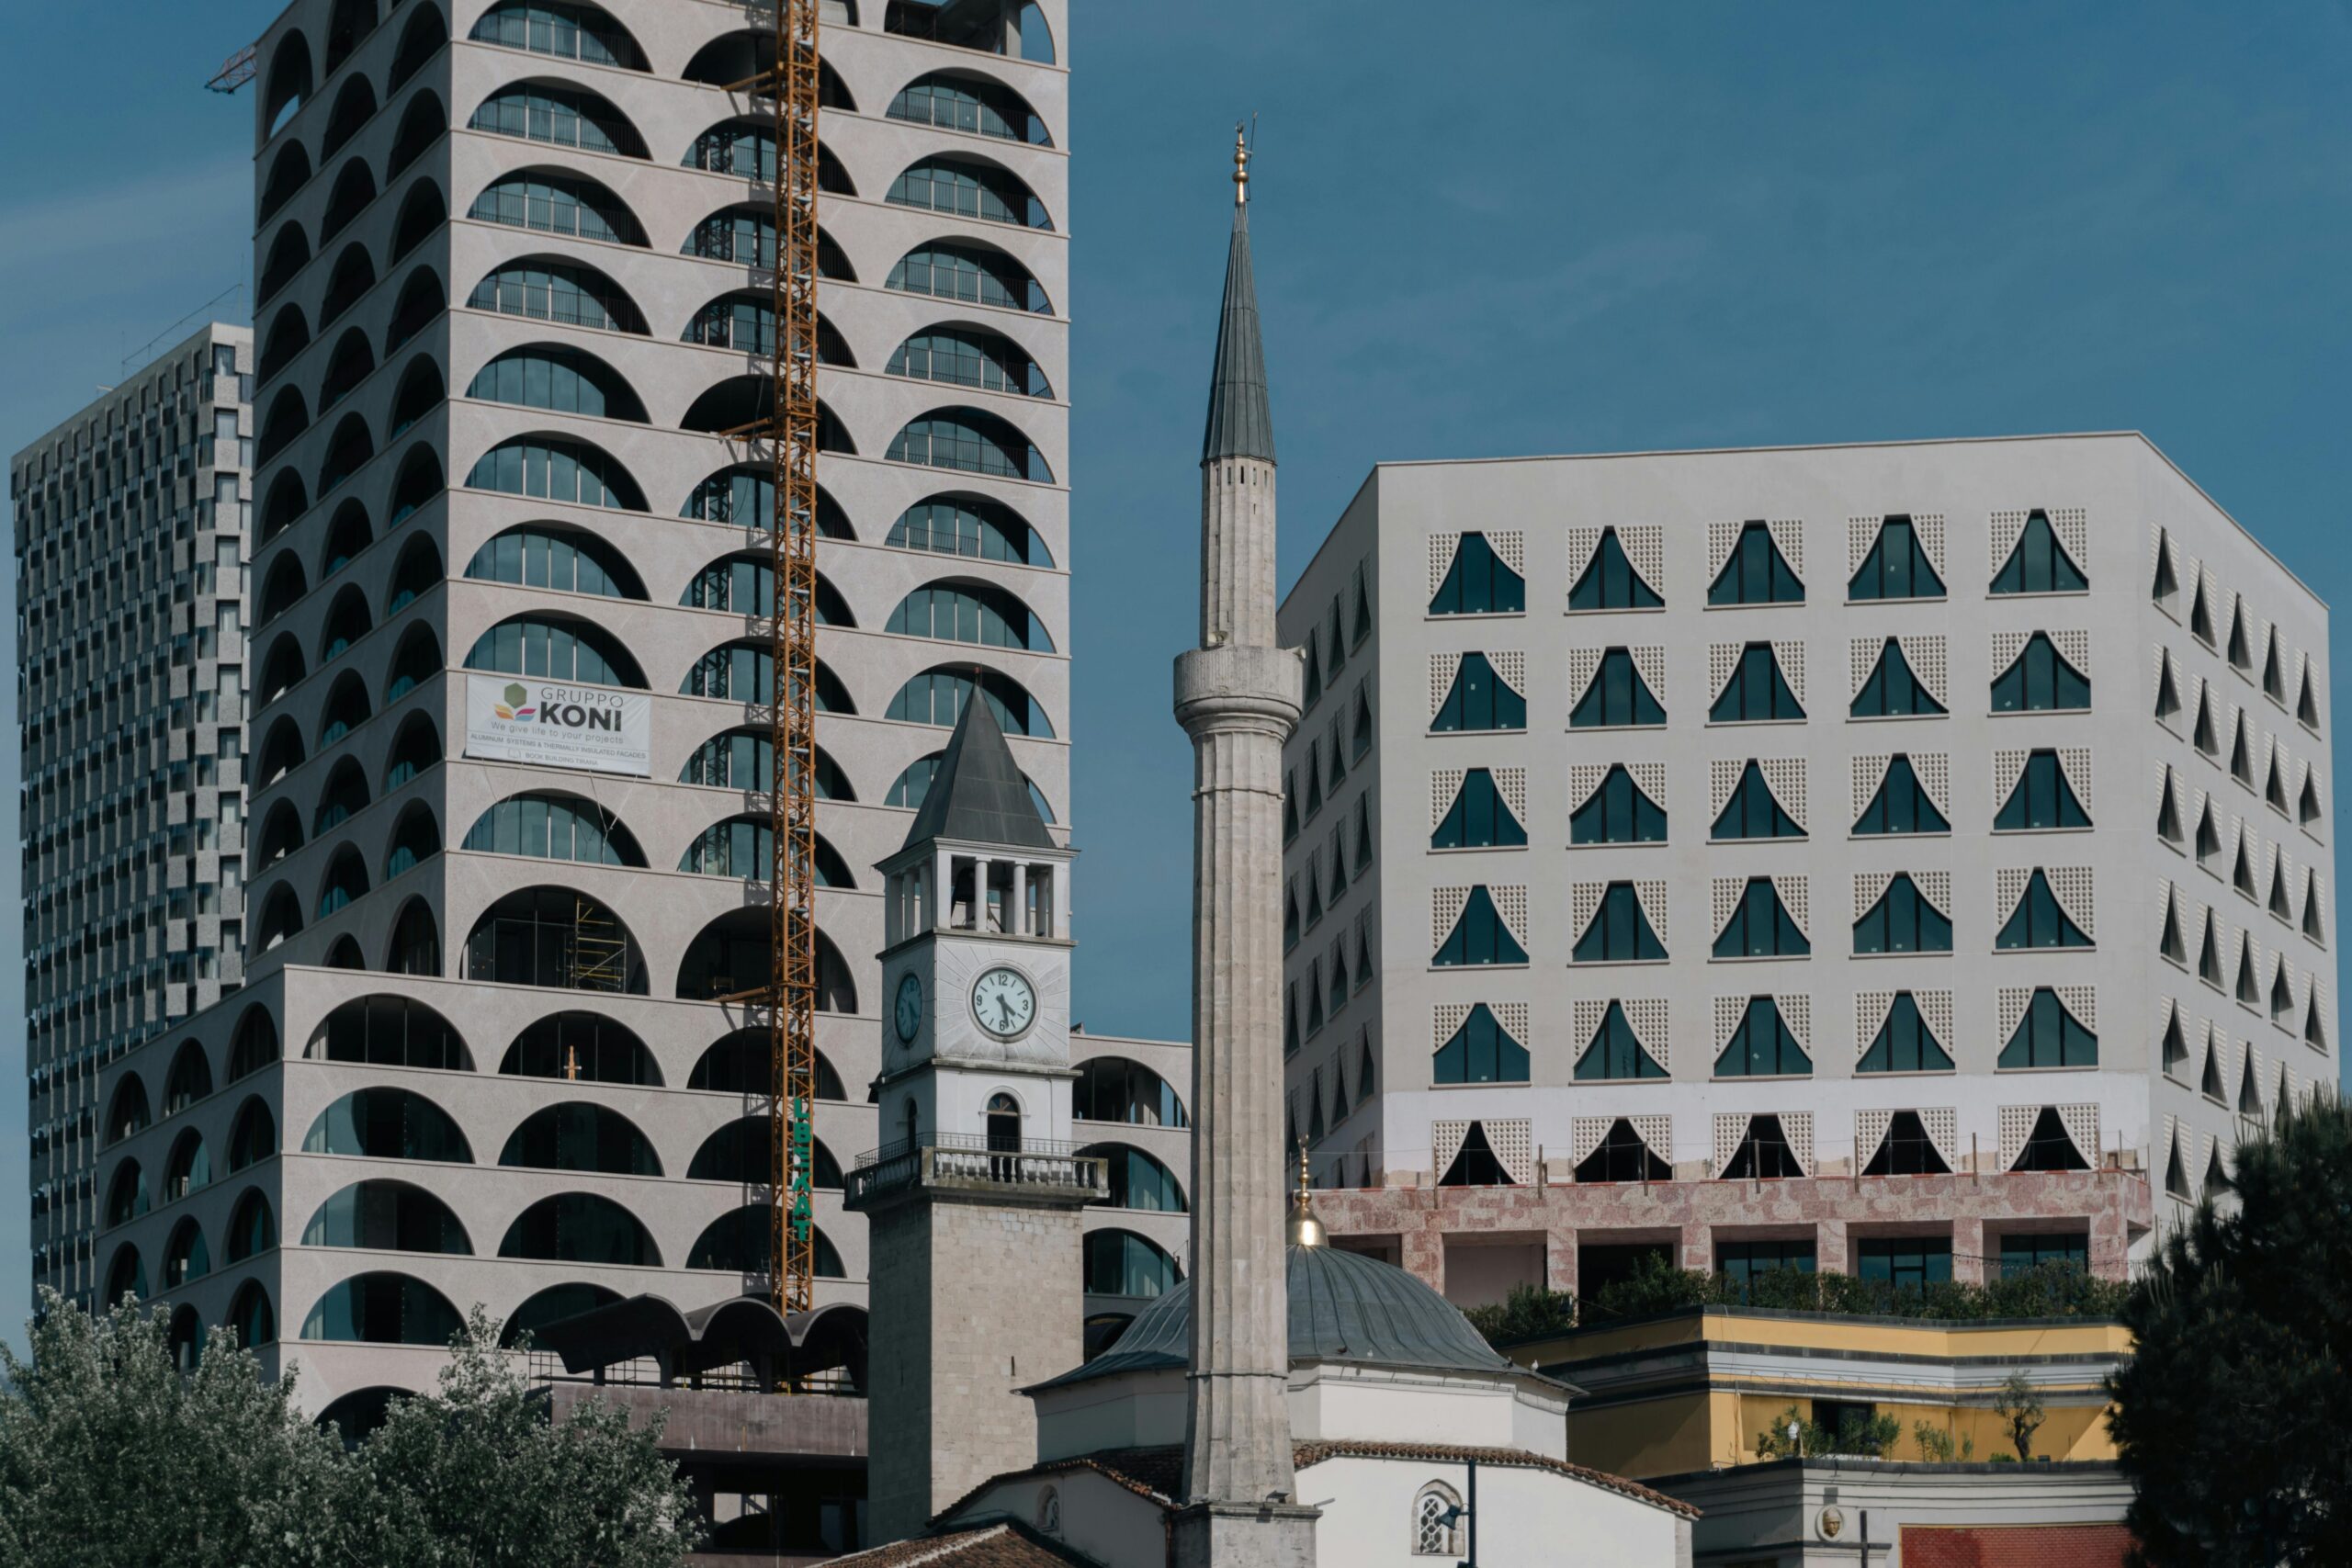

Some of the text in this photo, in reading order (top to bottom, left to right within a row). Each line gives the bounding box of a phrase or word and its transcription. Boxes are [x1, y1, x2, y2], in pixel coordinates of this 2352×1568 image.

[541, 687, 623, 707] GRUPPO
[540, 701, 622, 732] KONI
[492, 721, 505, 730] We
[509, 726, 528, 734] give
[532, 726, 546, 736] life
[585, 734, 624, 744] projects
[998, 974, 1008, 987] 12
[976, 994, 983, 1007] 9
[1022, 999, 1029, 1011] 3
[999, 1020, 1006, 1032] 6
